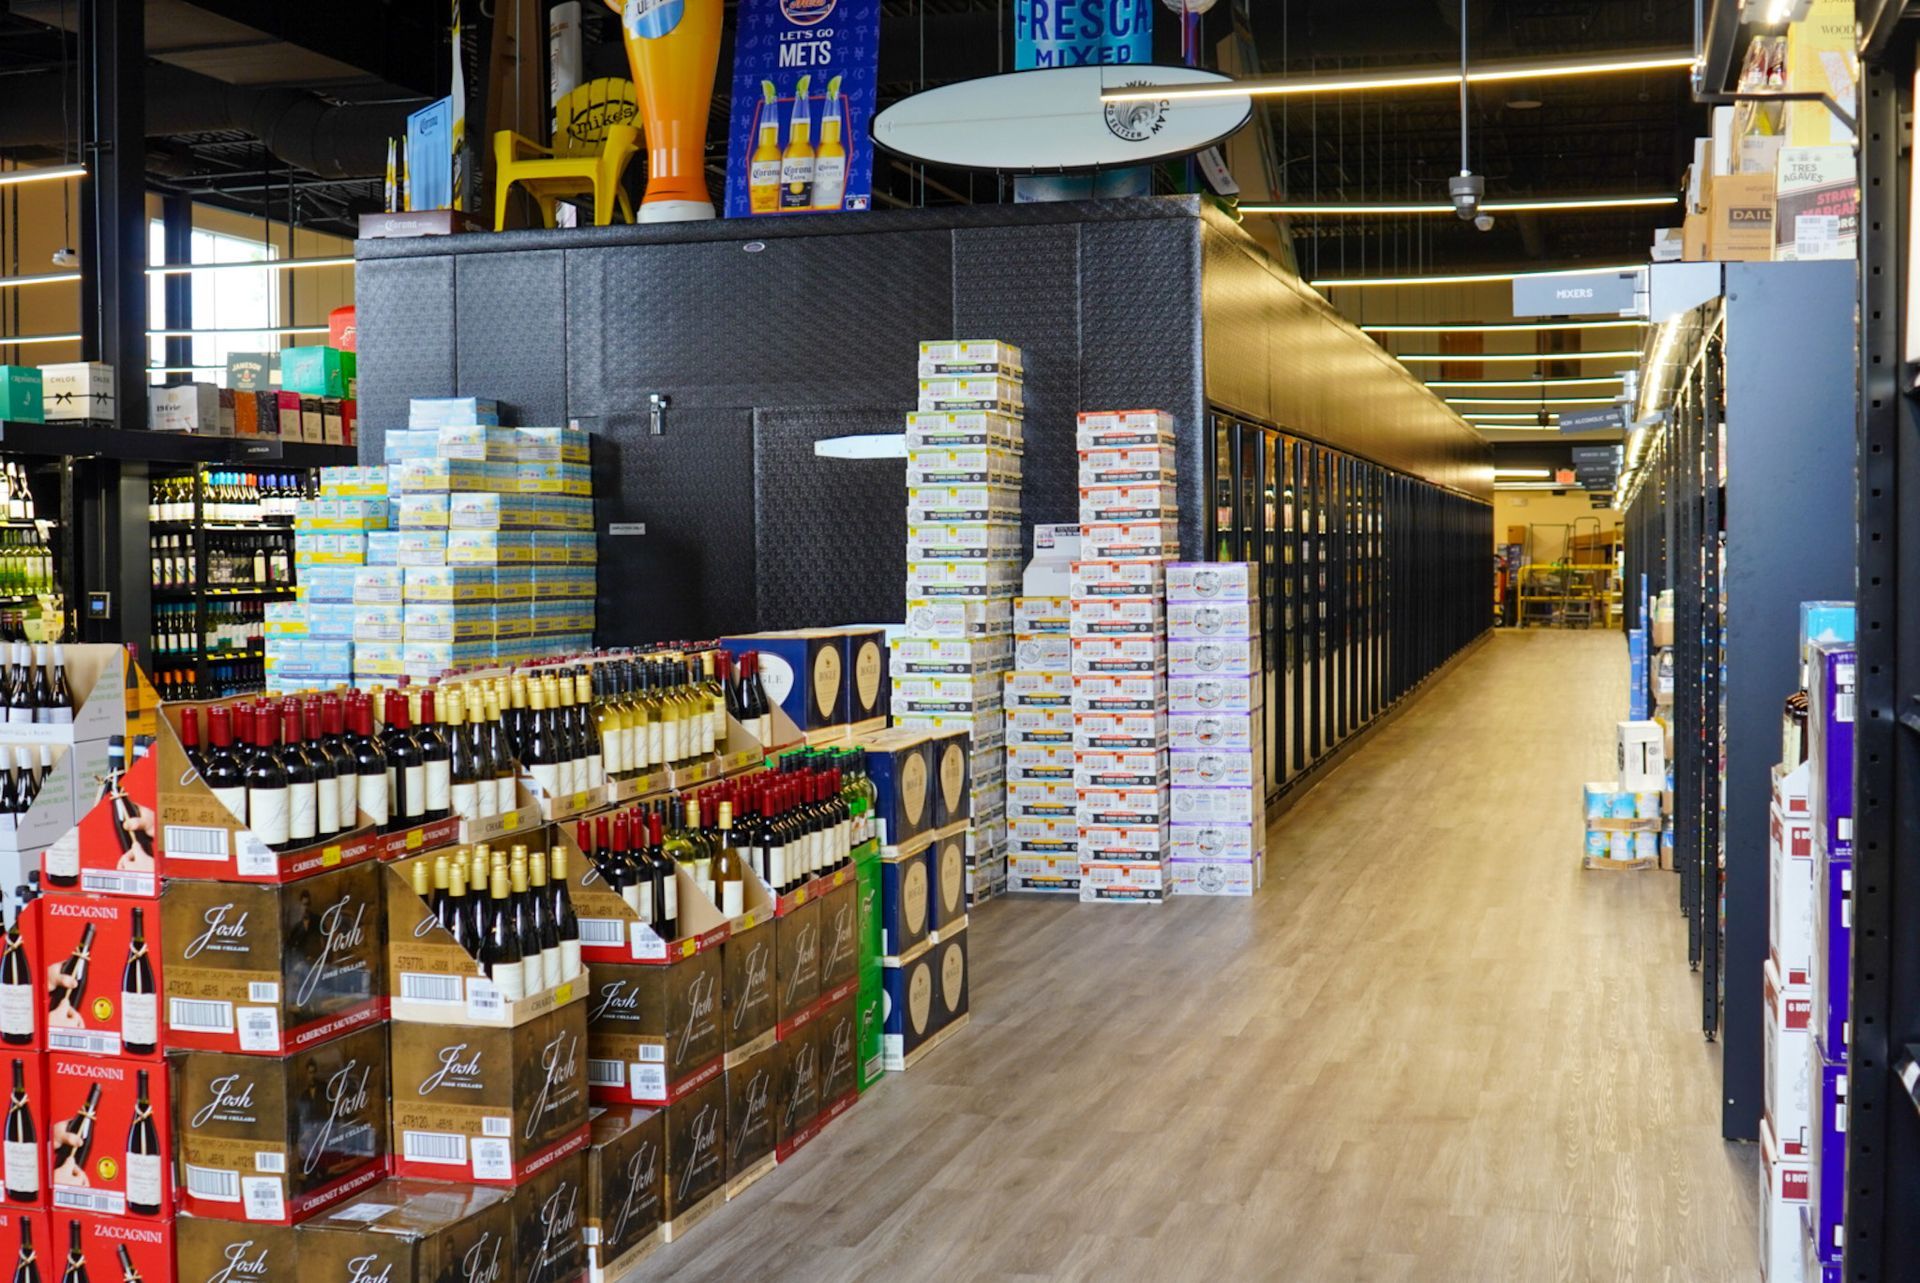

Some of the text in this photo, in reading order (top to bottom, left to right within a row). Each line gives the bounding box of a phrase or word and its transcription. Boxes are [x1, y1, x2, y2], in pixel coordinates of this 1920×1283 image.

[780, 28, 834, 41] LET'S GO
[1017, 0, 1150, 41] FRESCA
[779, 41, 832, 67] METS
[1036, 44, 1131, 67] MIXED
[1109, 118, 1143, 139] SELTZER
[1150, 99, 1170, 135] CLAW
[753, 168, 780, 180] Corona
[783, 163, 813, 177] Corona
[1783, 172, 1824, 184] AGAVES
[1791, 164, 1818, 172] TRES
[1556, 288, 1594, 299] MIXERS
[50, 375, 77, 384] CHLOE
[50, 903, 119, 920] ZACCAGNINI
[184, 903, 249, 960] Josh
[296, 894, 366, 1008] Josh
[786, 922, 816, 1006] Josh
[588, 980, 641, 1025] Josh
[733, 943, 769, 1030] Josh
[676, 970, 714, 1065] Josh
[1788, 1002, 1794, 1012] 6
[296, 1008, 371, 1045] CABERNET SAUVIGNON
[56, 1062, 124, 1081] ZACCAGNINI
[419, 1043, 482, 1096] Josh
[526, 1030, 578, 1140] Josh
[192, 1074, 255, 1129] Josh
[304, 1059, 370, 1177] Josh
[734, 1069, 770, 1159] Josh
[525, 1136, 582, 1174] CABERNET SAUVIGNON
[678, 1104, 718, 1201] Josh
[302, 1170, 376, 1212] CABERNET SAUVIGNON
[613, 1140, 657, 1245] Josh
[1785, 1173, 1791, 1182] 6
[94, 1225, 162, 1244] ZACCAGNINI
[527, 1182, 578, 1283] Josh
[208, 1240, 268, 1283] Josh
